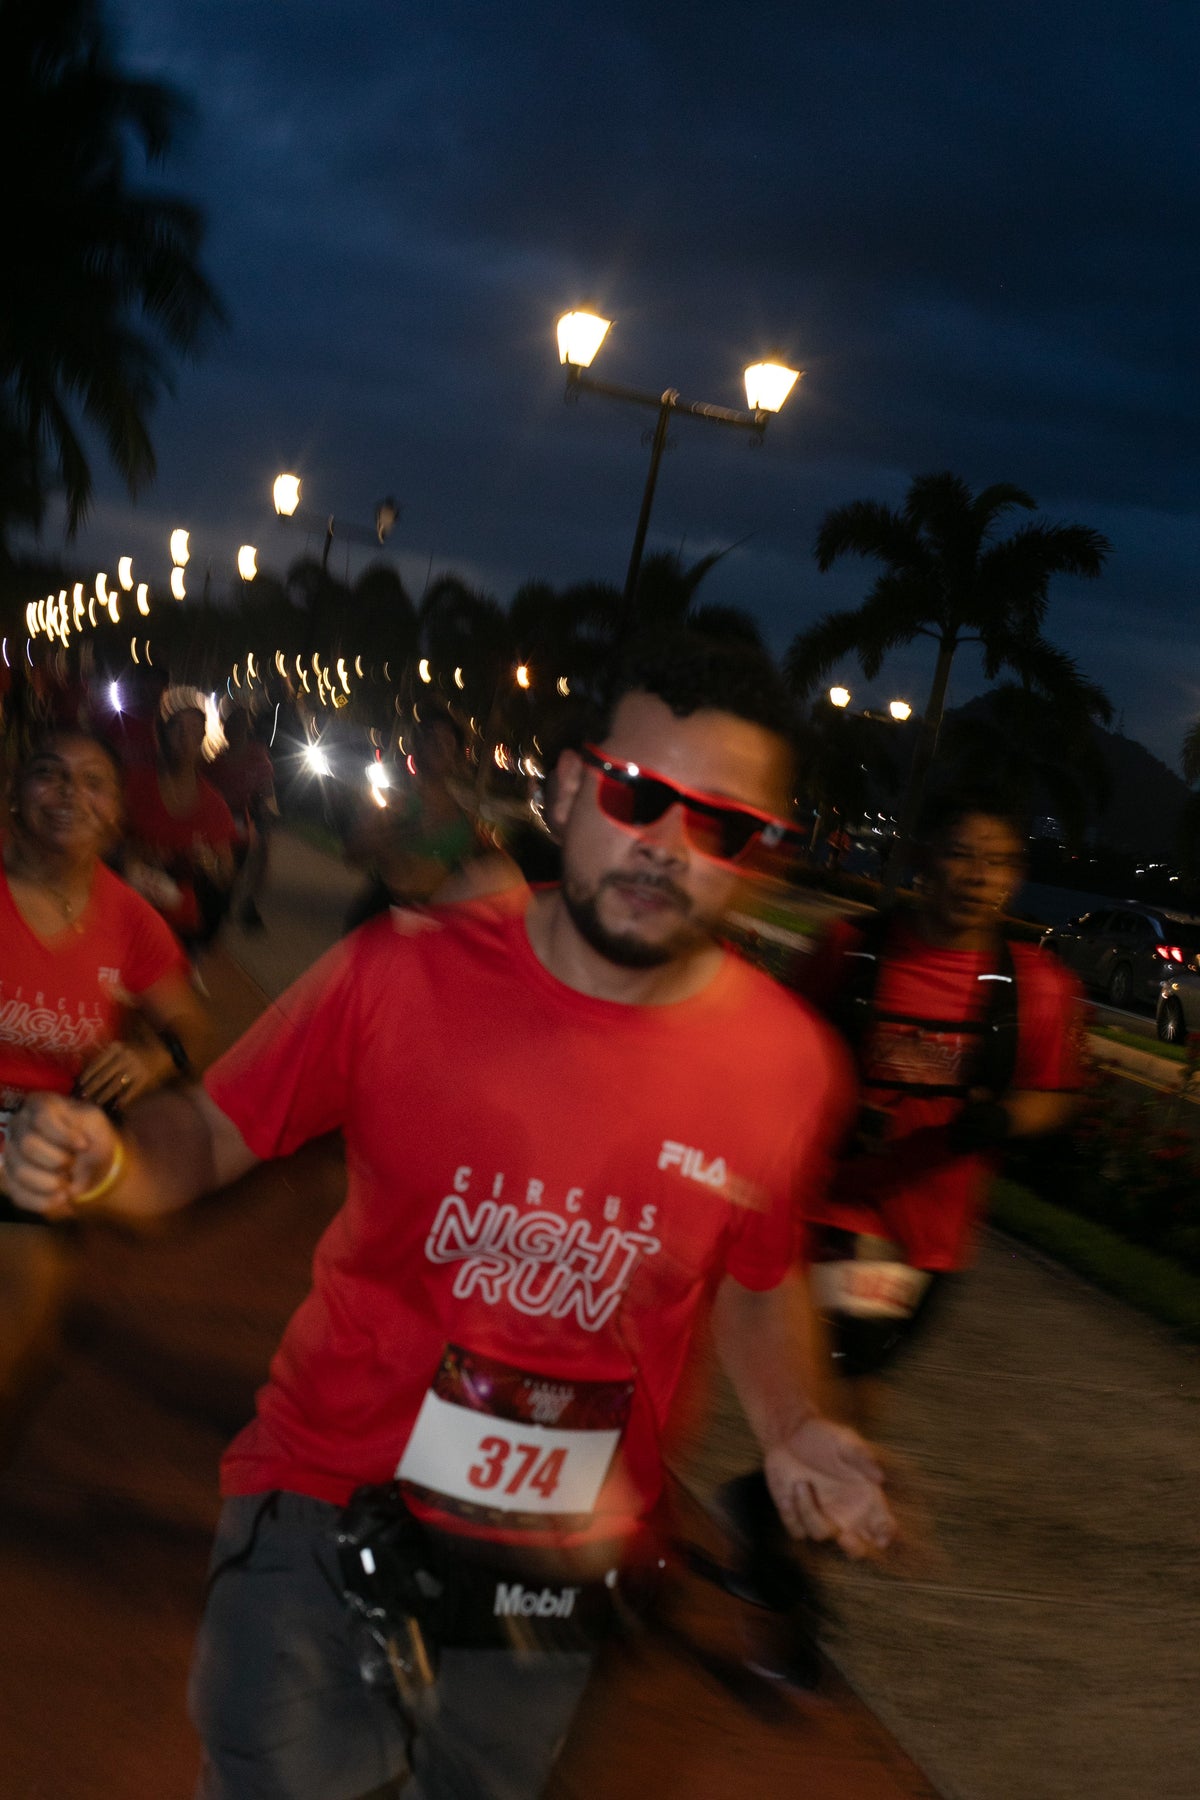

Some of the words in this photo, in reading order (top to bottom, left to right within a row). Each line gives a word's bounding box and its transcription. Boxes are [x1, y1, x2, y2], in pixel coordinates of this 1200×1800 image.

[658, 1140, 727, 1187] FILA
[453, 1166, 657, 1231] CIRCUS
[425, 1195, 661, 1283] NIGHT
[452, 1253, 622, 1332] RUN
[467, 1435, 570, 1499] 374
[493, 1583, 576, 1619] Mobil
